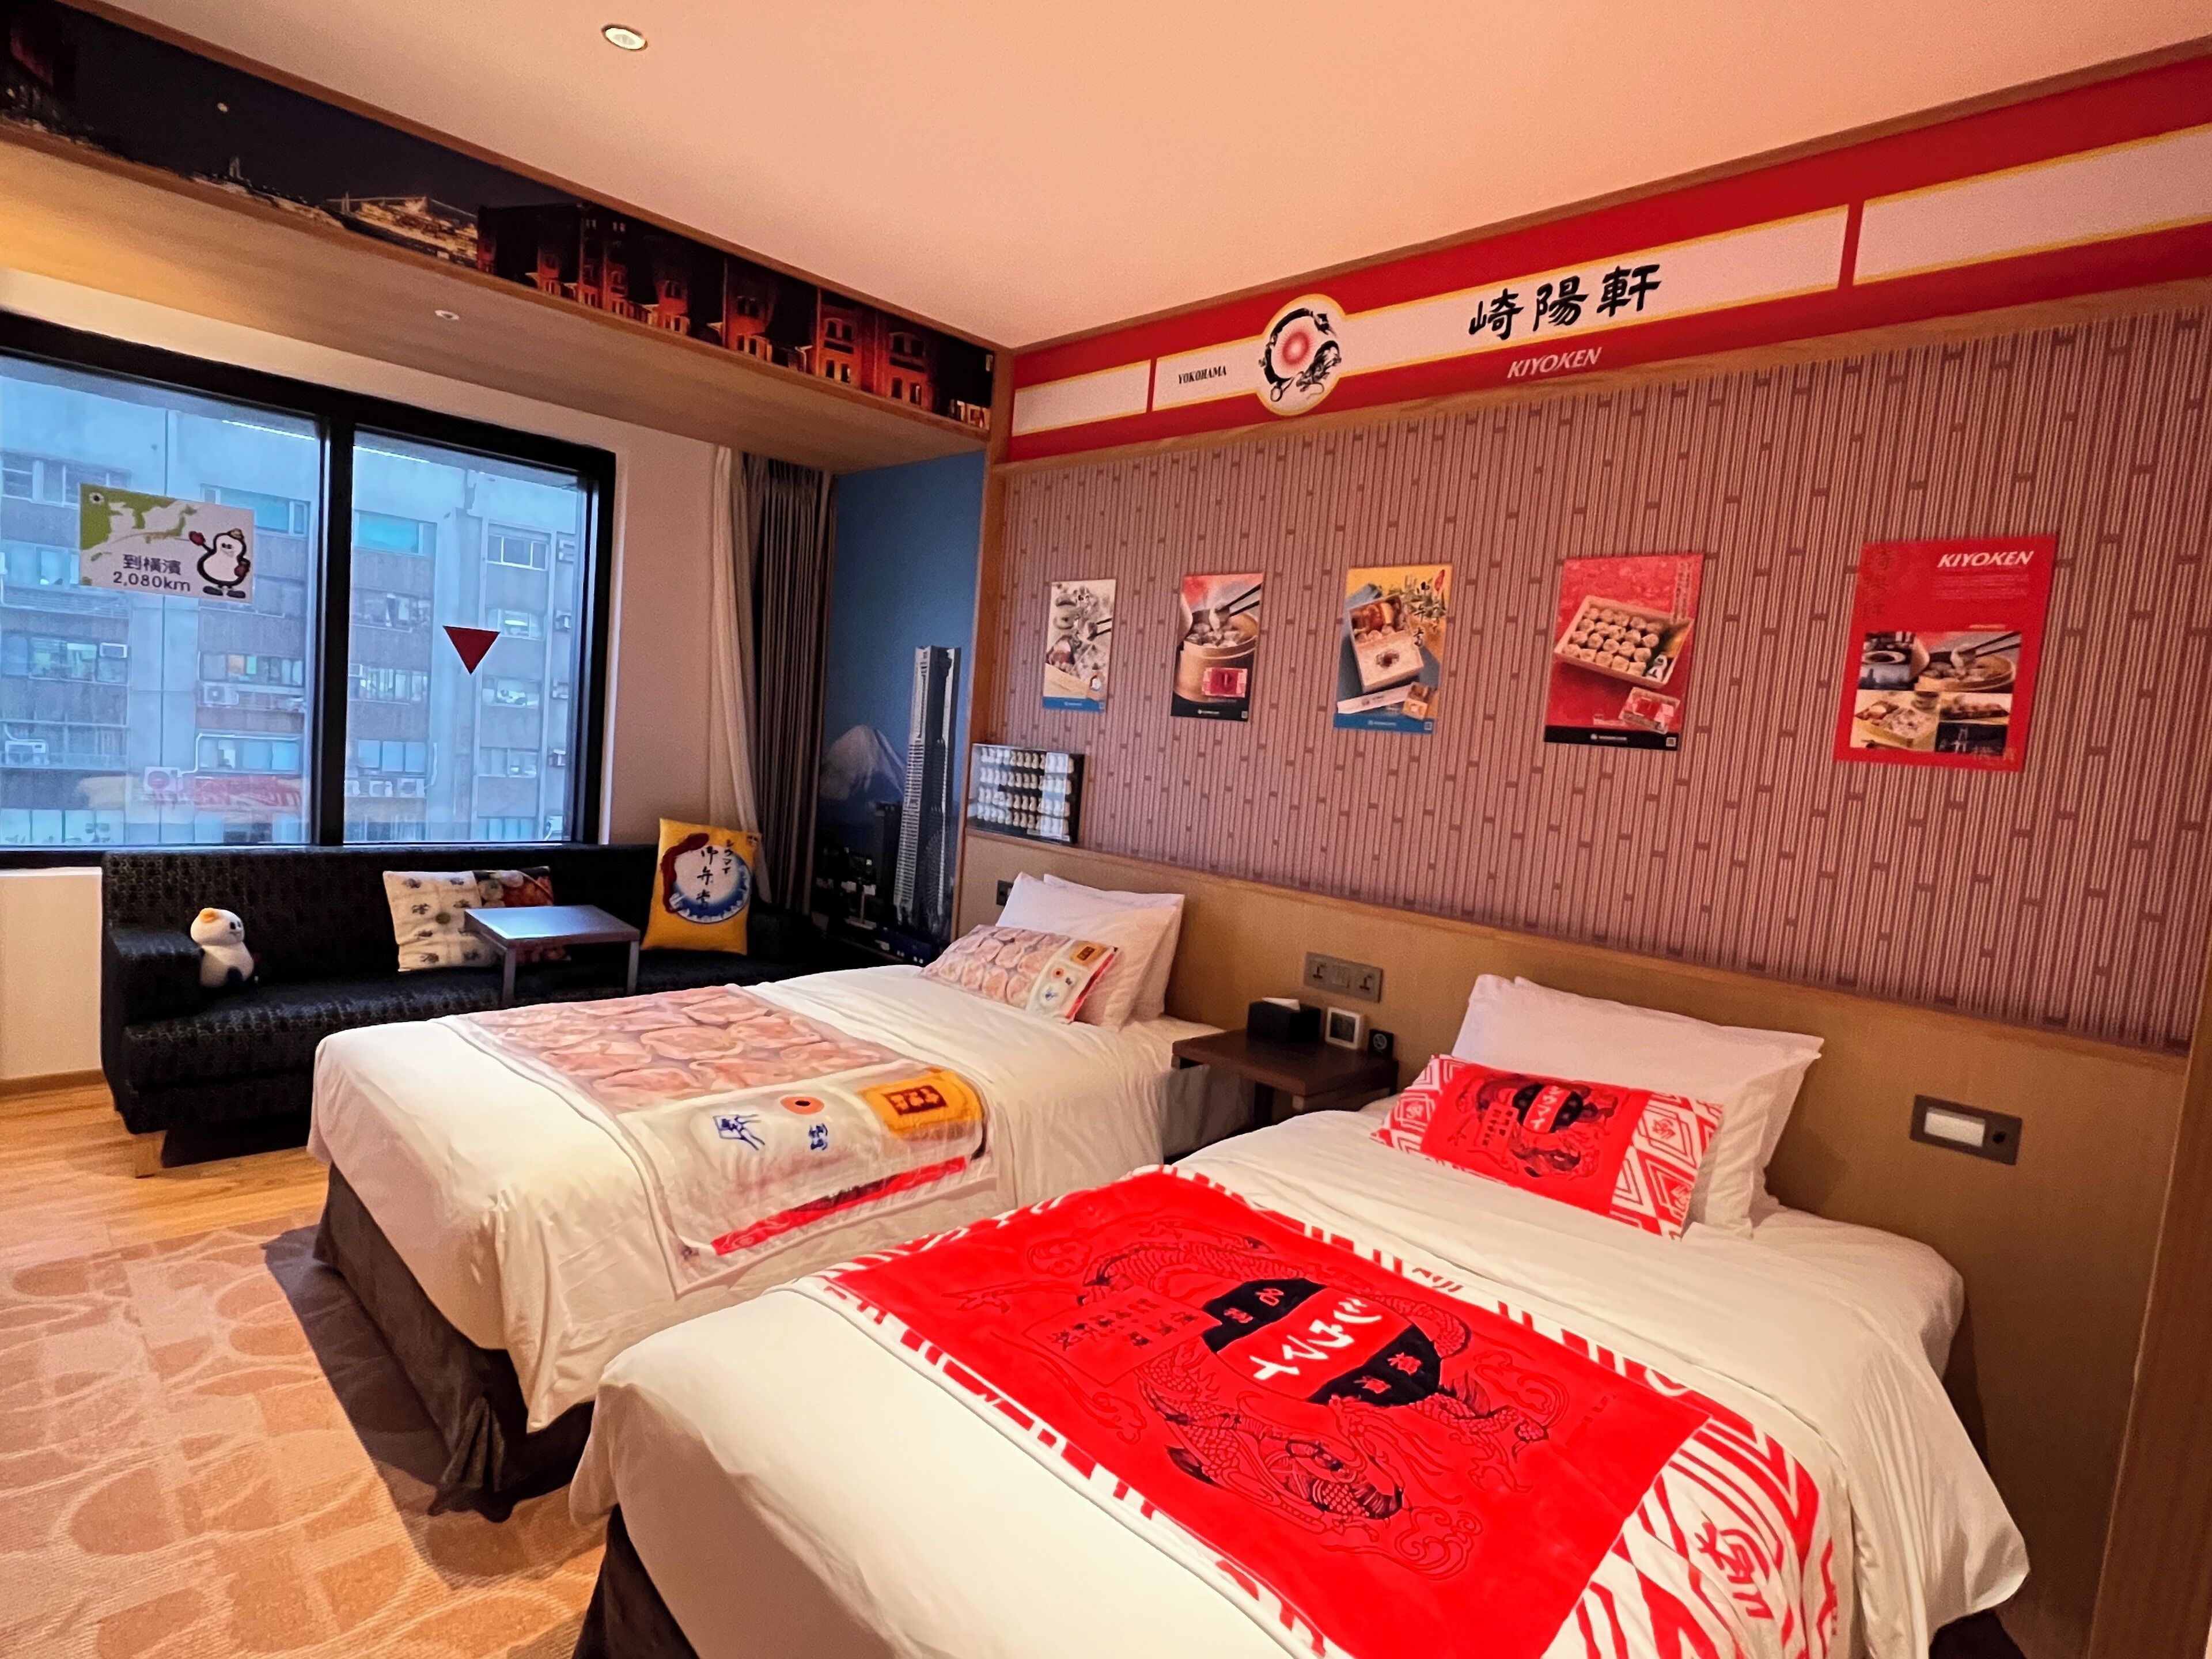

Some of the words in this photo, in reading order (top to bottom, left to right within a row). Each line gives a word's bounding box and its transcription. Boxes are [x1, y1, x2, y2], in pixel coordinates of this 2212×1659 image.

[1468, 264, 1662, 340] 崎陽軒
[1179, 365, 1226, 384] YOKOHAMA
[1507, 347, 1602, 378] KIYOKEN
[1937, 551, 2034, 568] KIYOKEN
[113, 571, 190, 592] 2,080km
[1529, 1085, 1565, 1131] シウマイ
[1249, 1297, 1382, 1380] シウマイ
